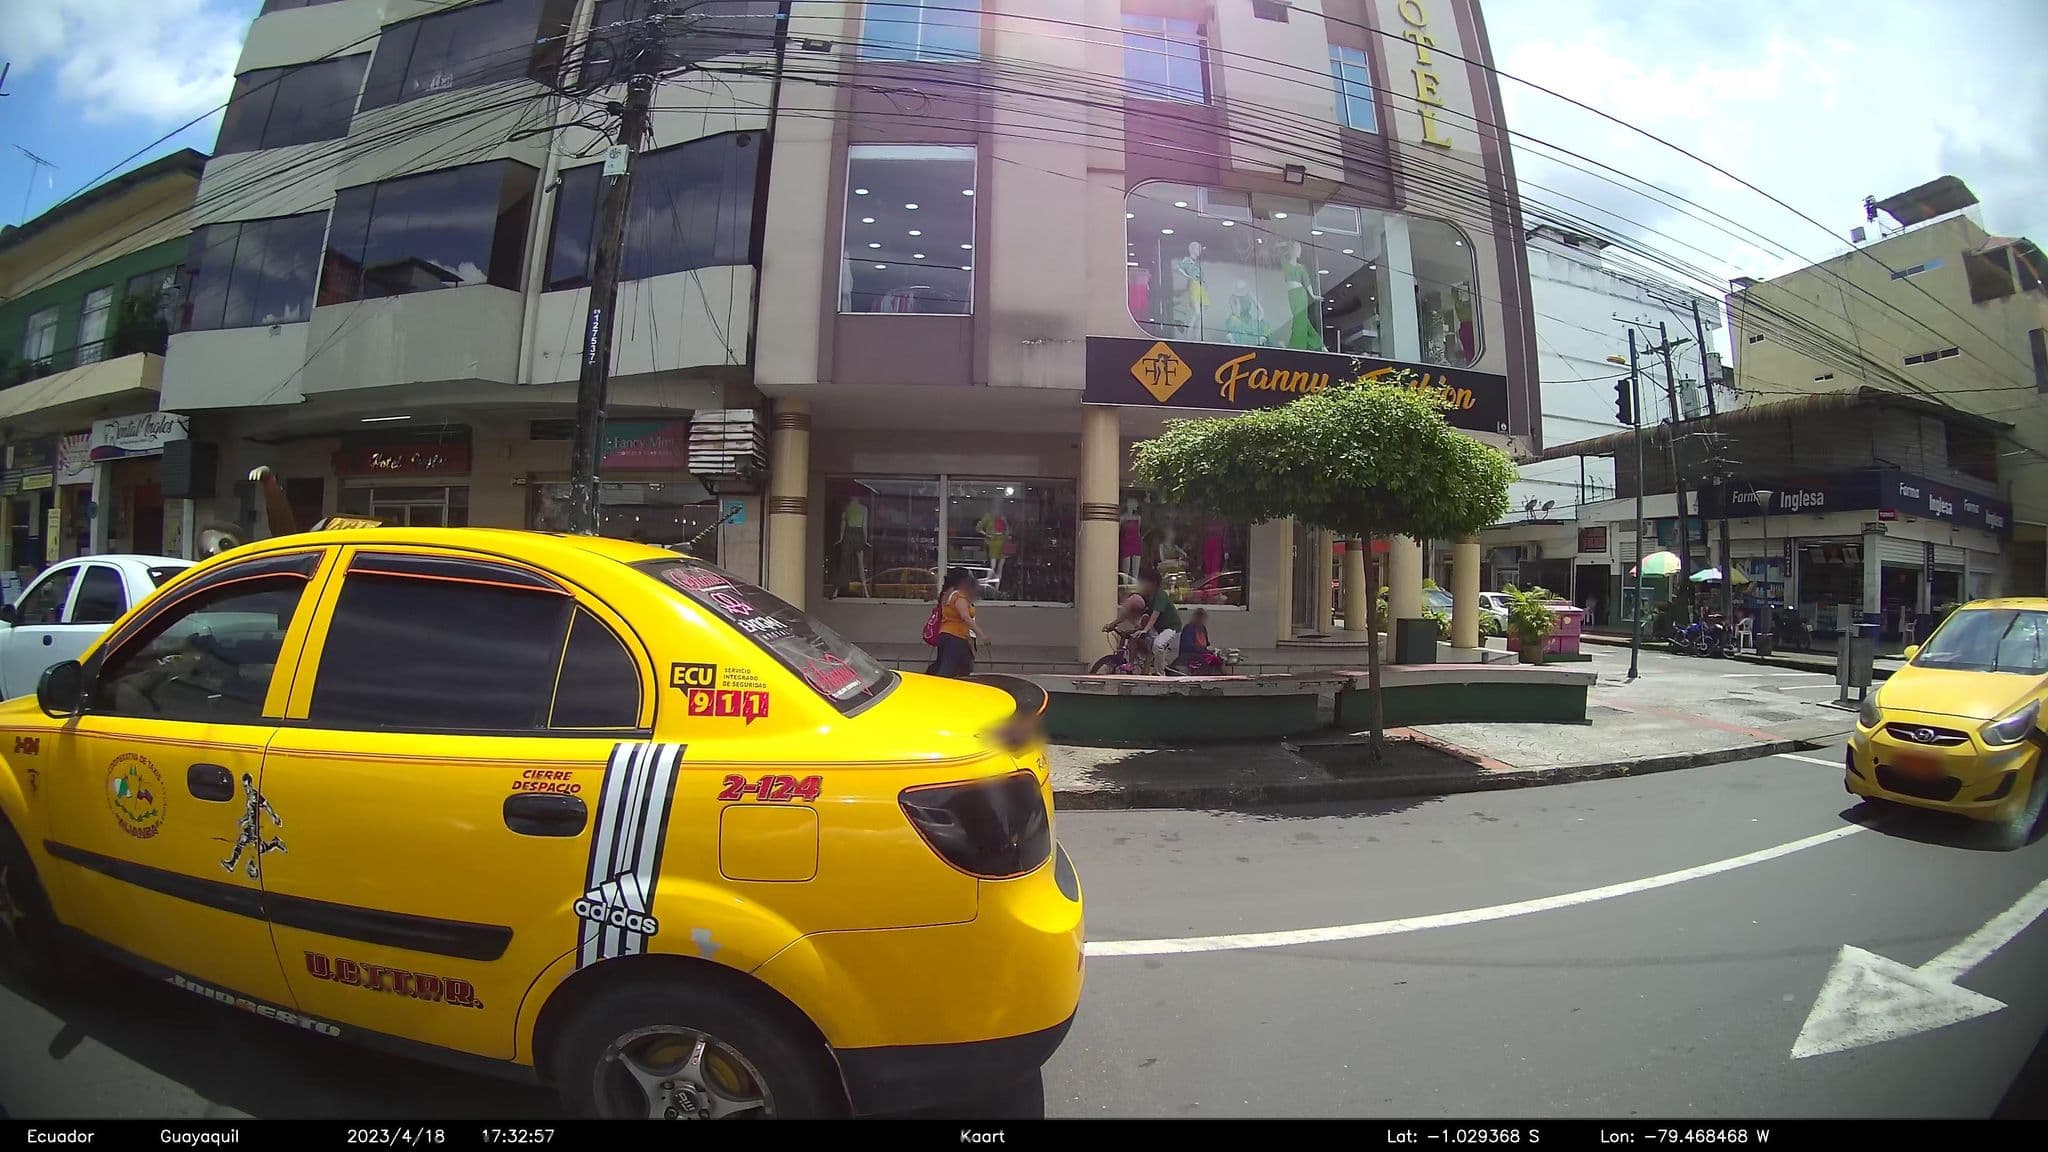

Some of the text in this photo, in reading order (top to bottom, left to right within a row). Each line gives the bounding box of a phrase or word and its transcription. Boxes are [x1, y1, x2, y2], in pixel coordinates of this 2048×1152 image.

[1214, 351, 1476, 410] Fanny Fhion
[1732, 490, 1824, 512] Farm Inglesa
[673, 666, 713, 686] ECU
[723, 674, 759, 682] INTEGRADO
[731, 681, 767, 689] SEGURIDAD
[693, 691, 761, 715] 911
[522, 769, 573, 782] CIERRE
[511, 779, 582, 795] DESPACIO
[717, 774, 823, 802] 2-124
[575, 898, 658, 935] adidas
